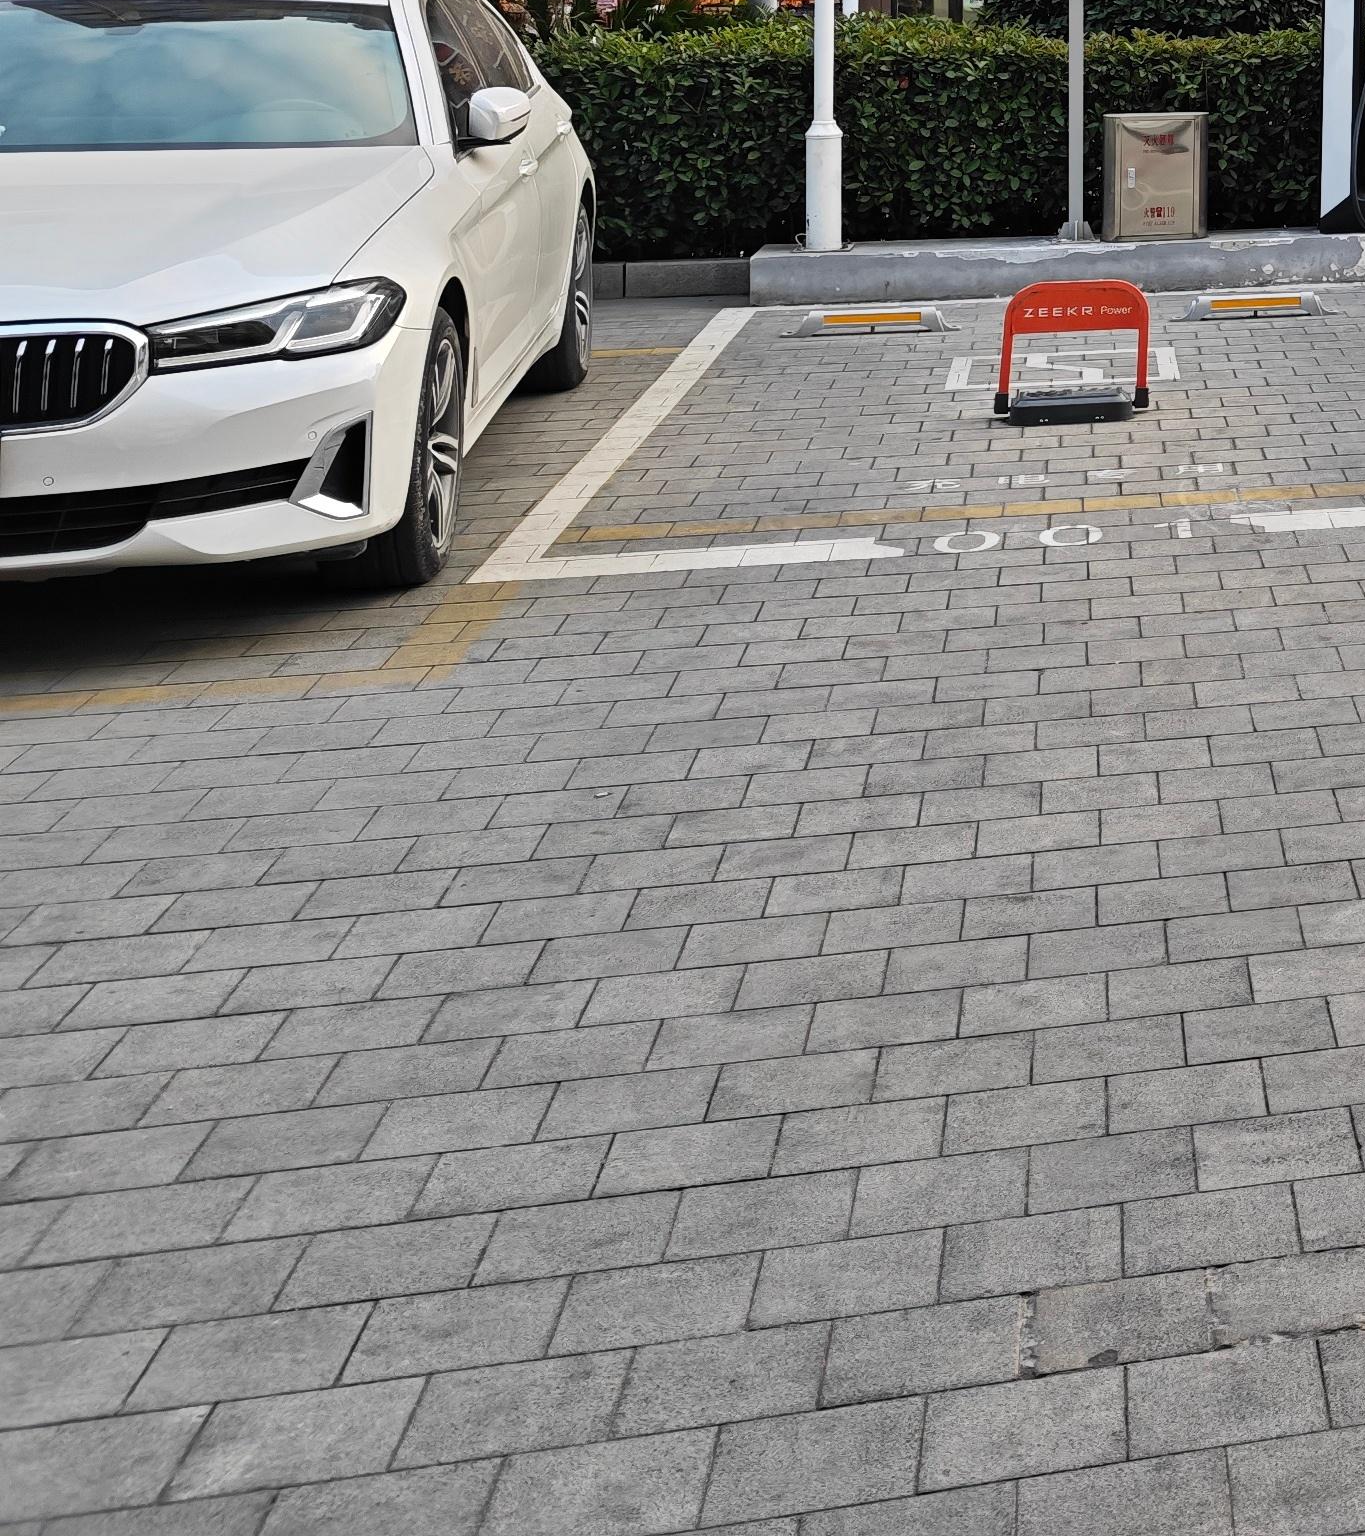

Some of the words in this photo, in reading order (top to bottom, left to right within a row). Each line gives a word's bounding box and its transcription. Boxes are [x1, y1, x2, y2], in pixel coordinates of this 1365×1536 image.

[1023, 306, 1093, 318] ZEEKR
[1100, 305, 1133, 316] Power
[933, 517, 1195, 554] 001
